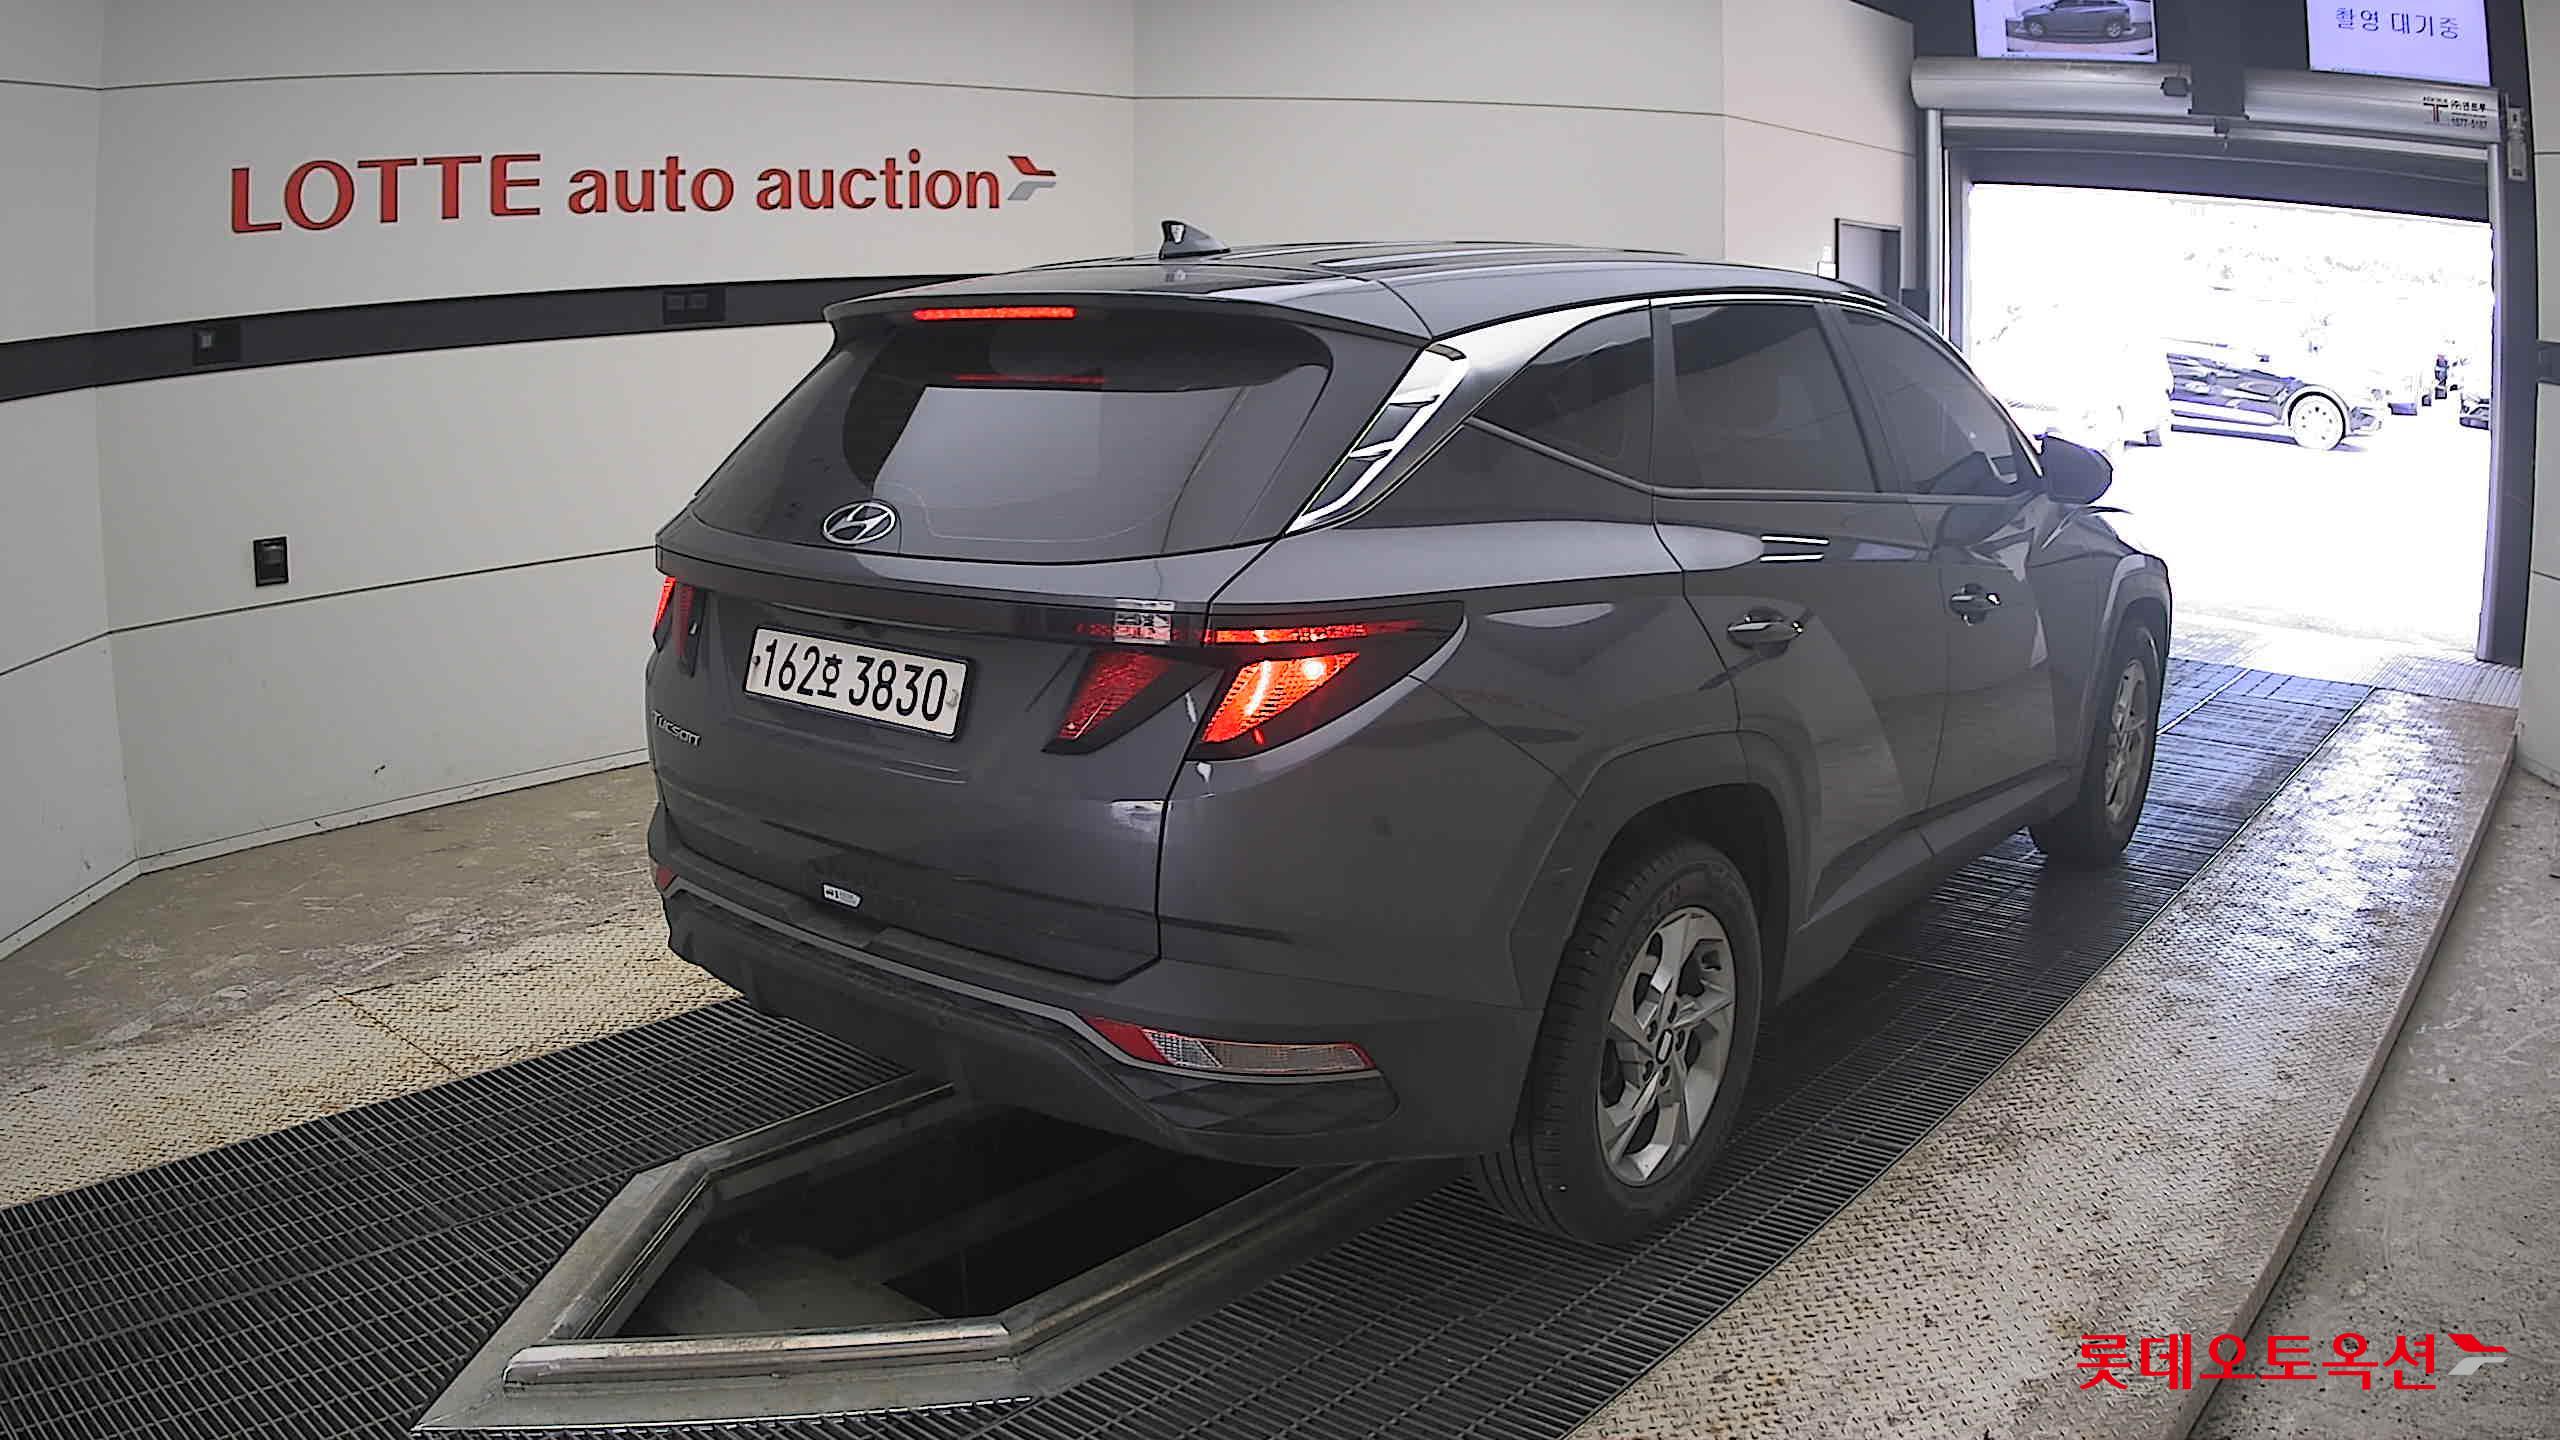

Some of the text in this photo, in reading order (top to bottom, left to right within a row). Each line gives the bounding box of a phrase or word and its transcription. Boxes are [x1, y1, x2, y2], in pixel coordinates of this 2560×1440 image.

[2336, 7, 2460, 40] 촬영 대기중
[231, 148, 1001, 235] LOTTE auto auction
[764, 638, 948, 722] 162호 3830
